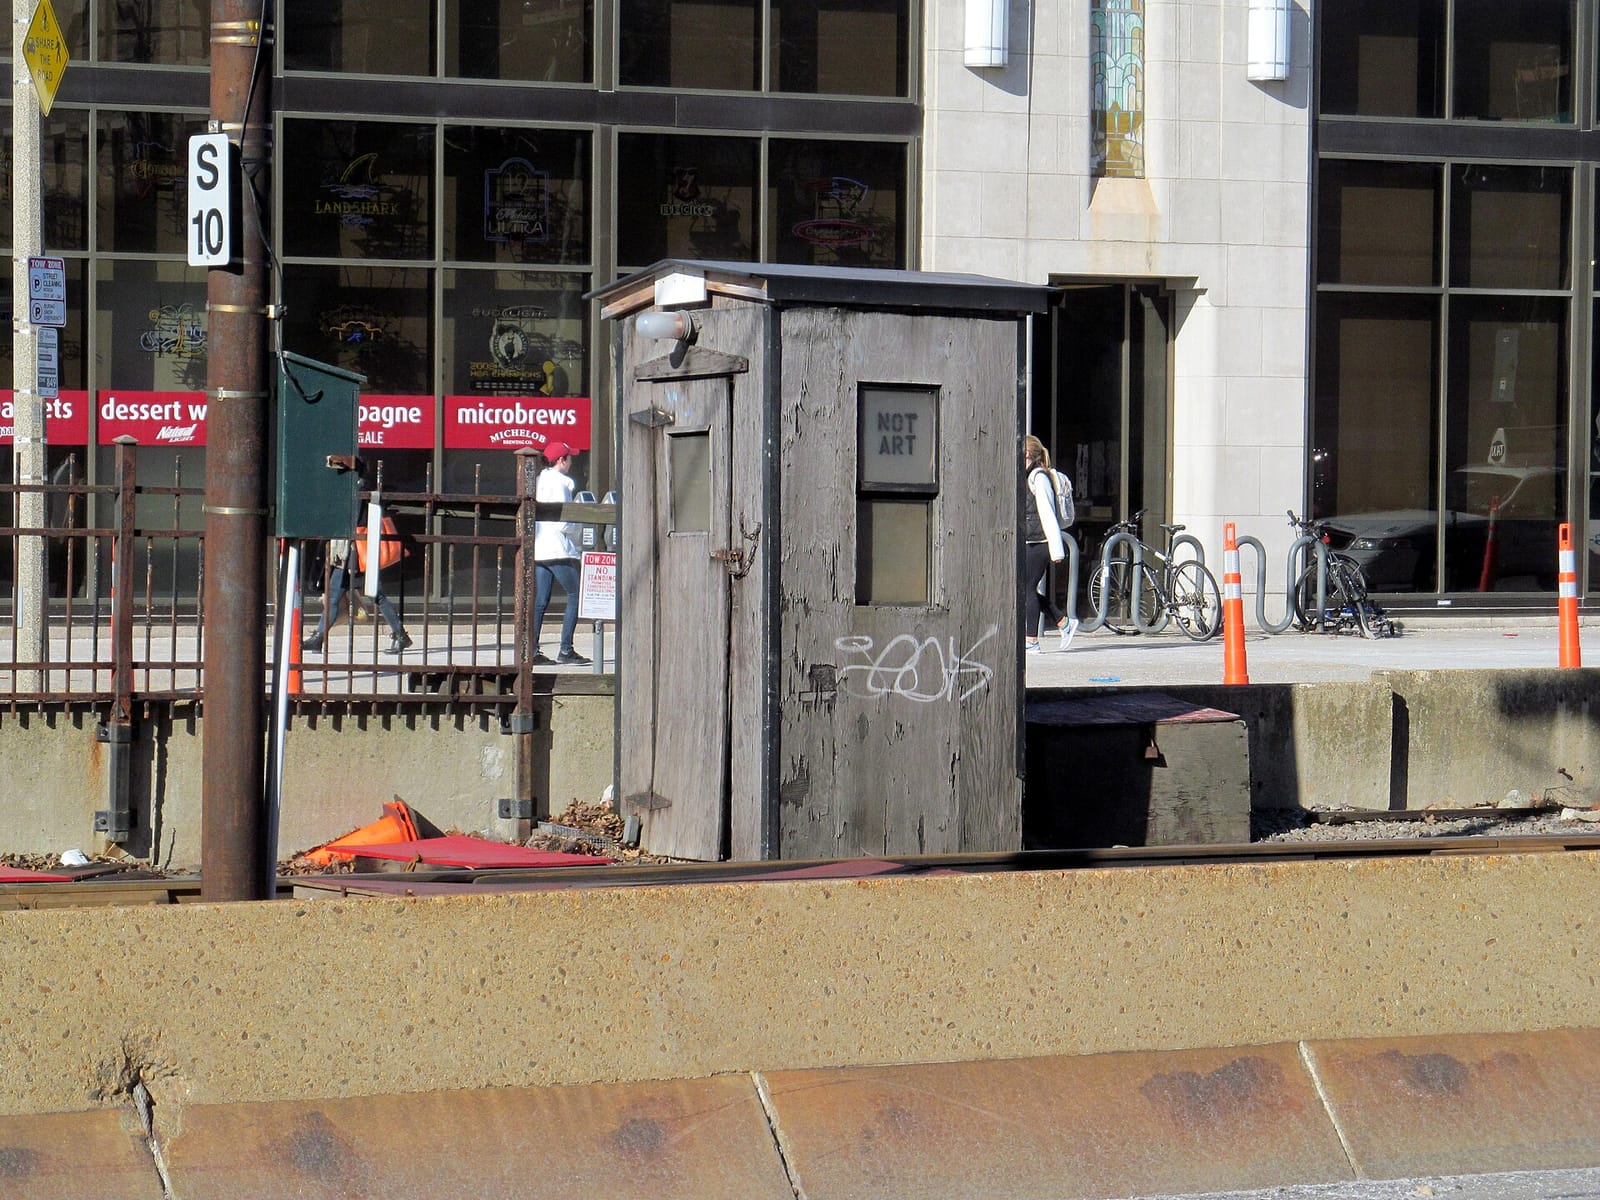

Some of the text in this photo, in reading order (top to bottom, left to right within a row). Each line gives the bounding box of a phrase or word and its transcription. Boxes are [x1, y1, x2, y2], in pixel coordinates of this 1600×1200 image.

[36, 37, 55, 50] SHARE
[40, 54, 51, 65] THE
[38, 69, 53, 81] ROAD
[196, 144, 219, 190] S
[314, 199, 401, 216] LANDSHARK
[192, 208, 223, 255] 10
[30, 259, 63, 270] TOW ZONE
[101, 397, 182, 420] dessert
[358, 405, 422, 428] pagne
[457, 402, 577, 425] microbrews
[878, 412, 918, 433] NOT
[489, 428, 547, 443] MICHELOB
[878, 435, 916, 455] ART
[586, 555, 616, 565] TOW ZON
[596, 567, 608, 575] NO
